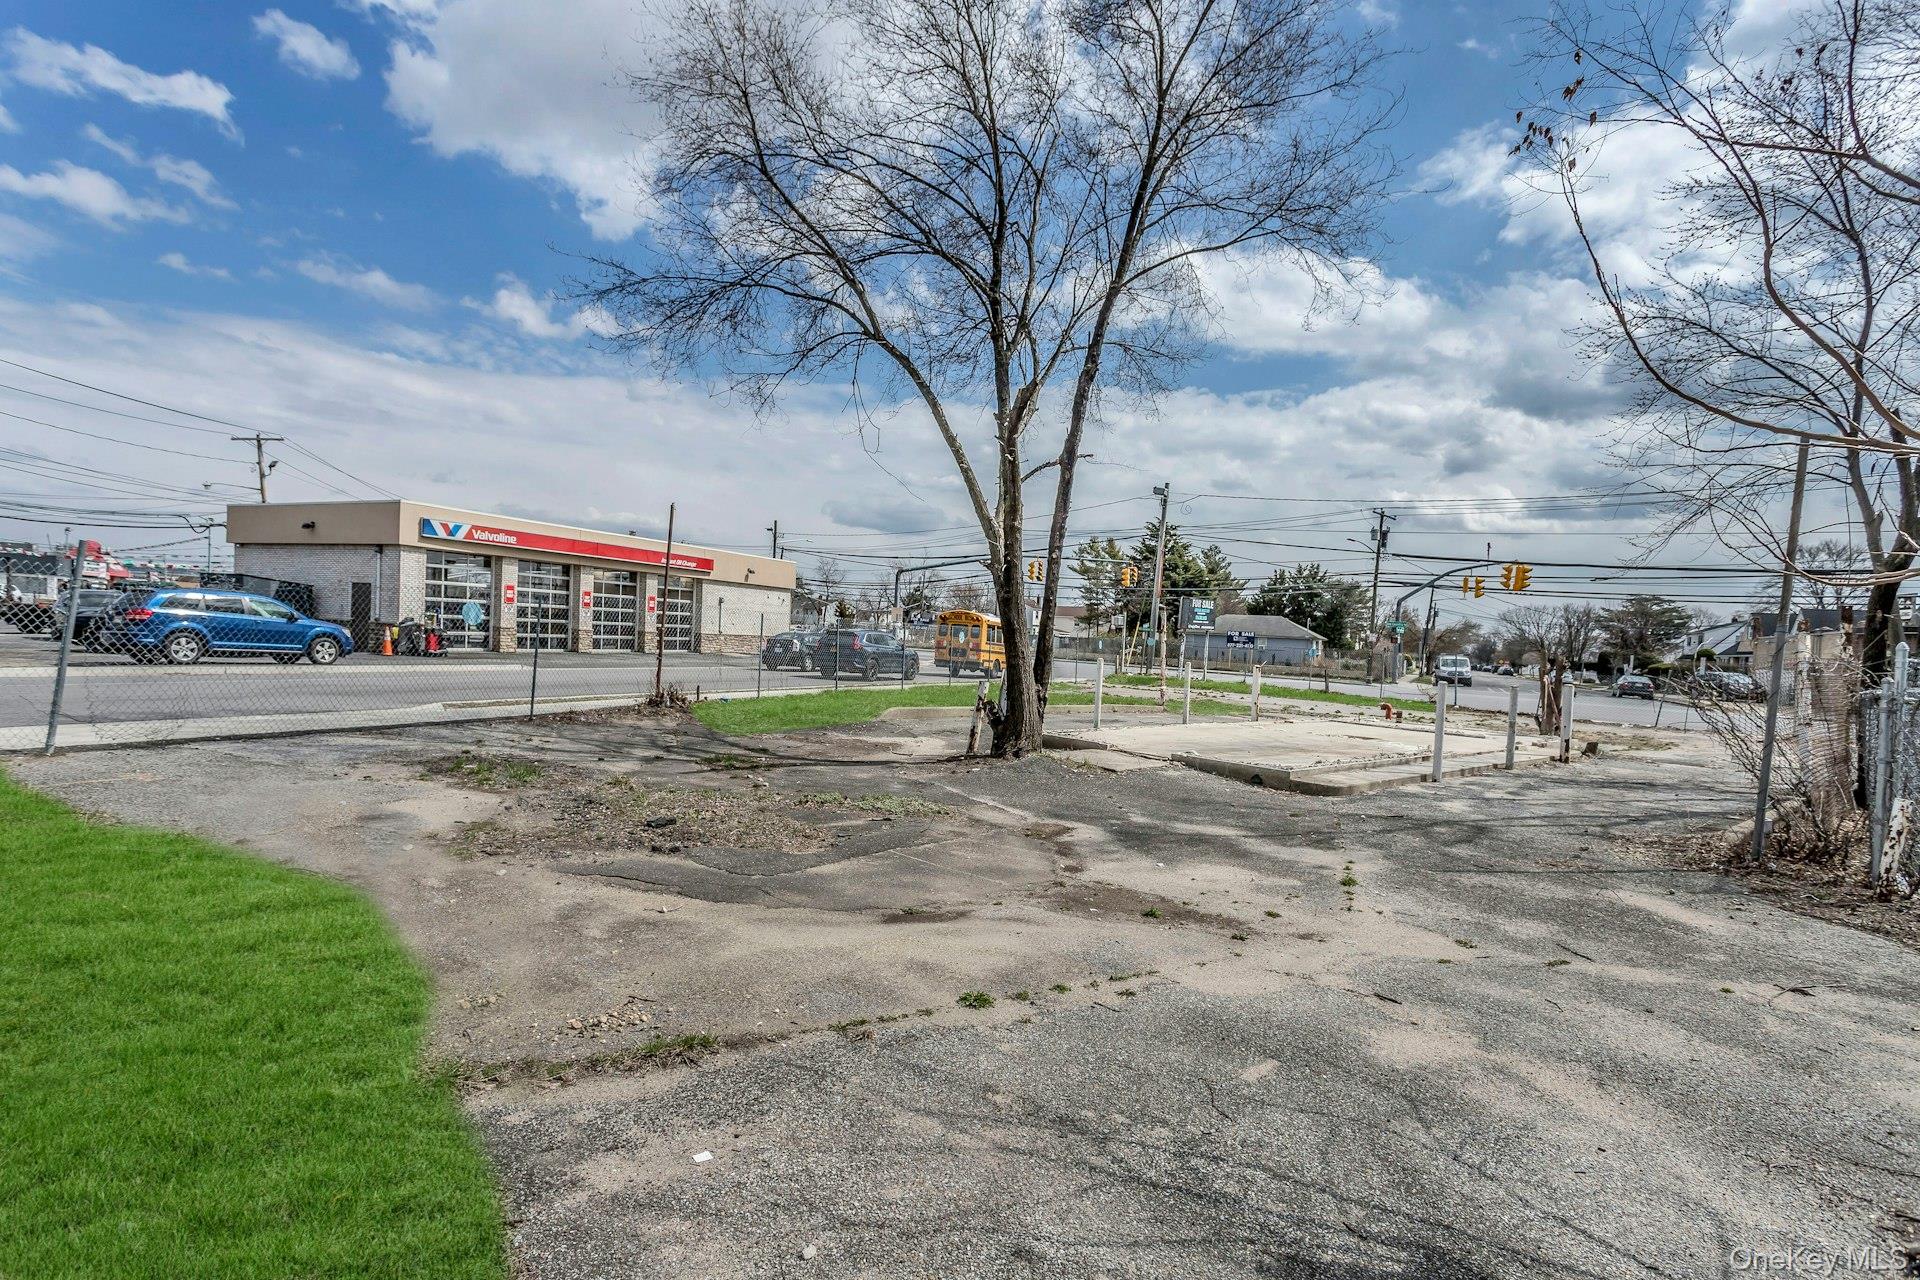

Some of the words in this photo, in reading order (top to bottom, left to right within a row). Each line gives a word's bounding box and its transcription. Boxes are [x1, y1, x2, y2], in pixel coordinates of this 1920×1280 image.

[472, 529, 518, 544] Valvoline
[1192, 599, 1202, 608] FOR
[1202, 600, 1215, 610] SALE
